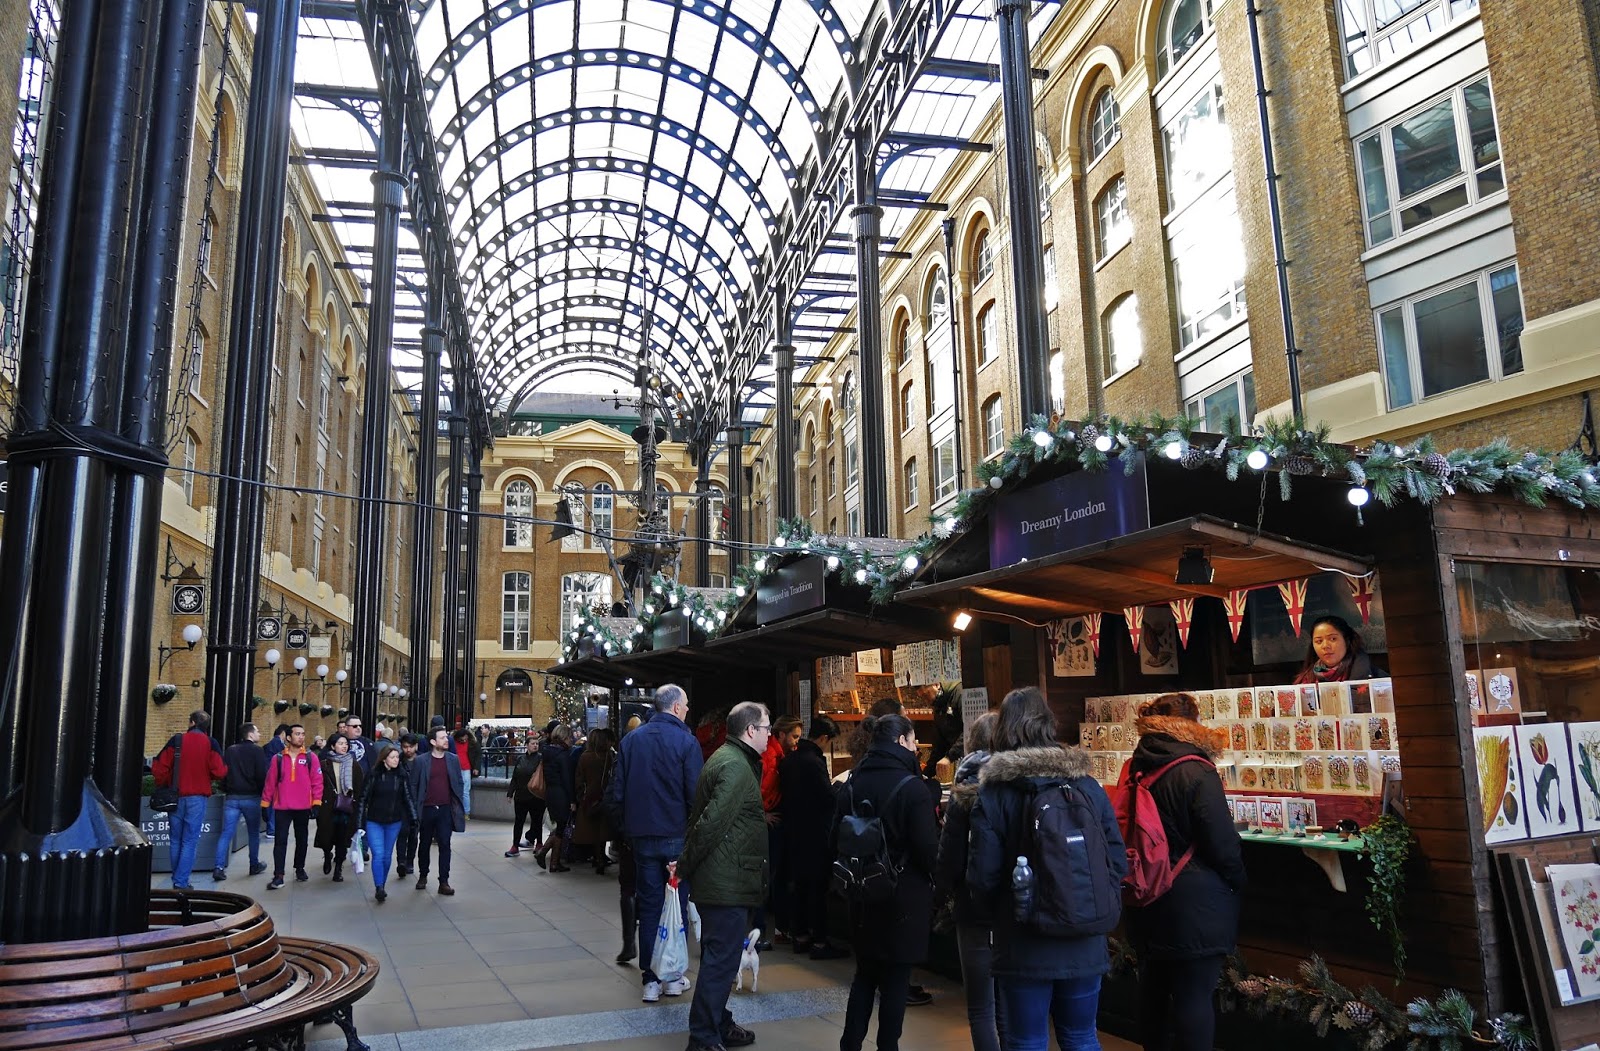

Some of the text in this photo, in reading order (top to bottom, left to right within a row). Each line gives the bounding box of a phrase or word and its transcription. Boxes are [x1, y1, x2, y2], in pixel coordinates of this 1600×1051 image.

[1021, 501, 1106, 535] Dreamy London
[789, 581, 813, 596] Tradition
